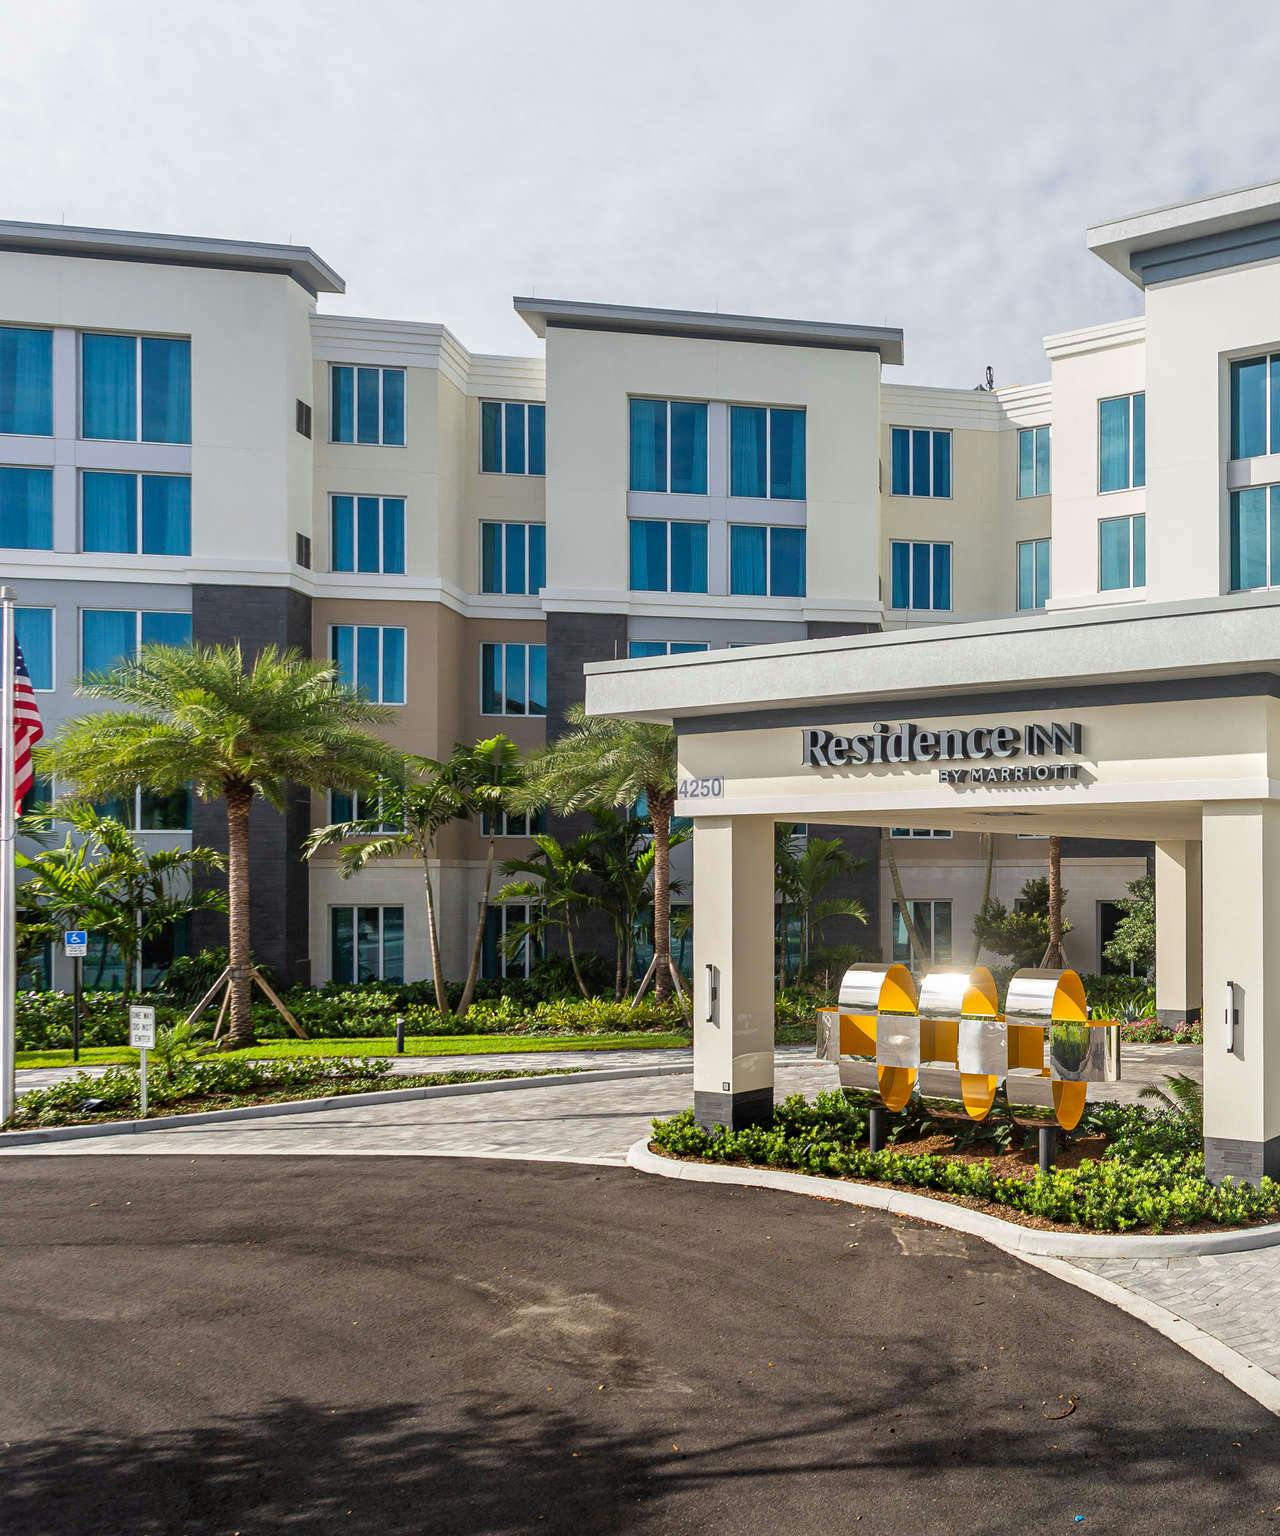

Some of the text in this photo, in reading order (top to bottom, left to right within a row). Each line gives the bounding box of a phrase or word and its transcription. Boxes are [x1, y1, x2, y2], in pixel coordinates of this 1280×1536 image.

[801, 720, 1082, 768] Residence INN
[939, 764, 1080, 784] BY MARRIOTT
[678, 777, 722, 798] 4250
[132, 1023, 152, 1031] DO NOT
